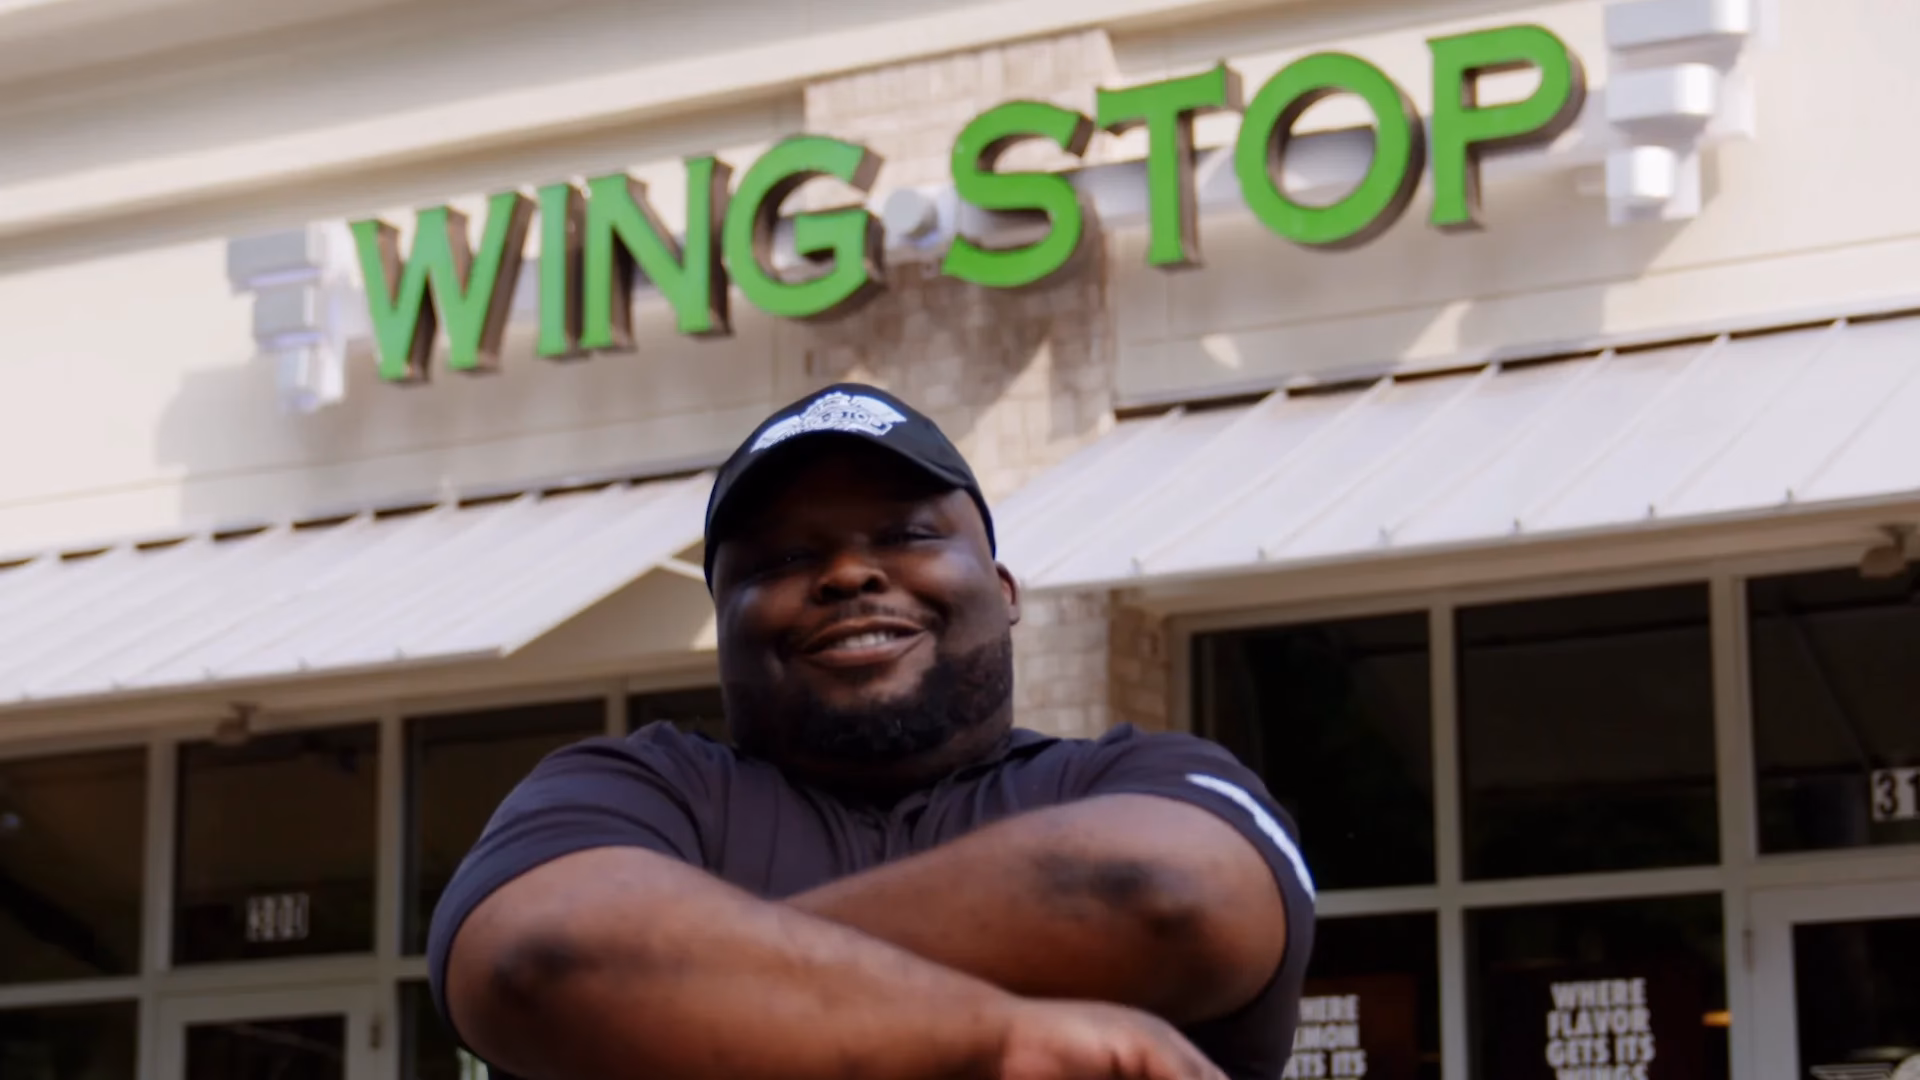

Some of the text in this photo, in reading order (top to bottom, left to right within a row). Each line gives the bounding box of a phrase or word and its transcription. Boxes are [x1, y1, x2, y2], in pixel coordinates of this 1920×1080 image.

[350, 23, 1582, 383] WING STOP
[1299, 995, 1359, 1022] HERE
[1550, 978, 1646, 1009] WHERE
[1547, 1006, 1651, 1039] FLAVOR
[1331, 1050, 1367, 1077] ITS
[1545, 1033, 1656, 1068] GETS ITS
